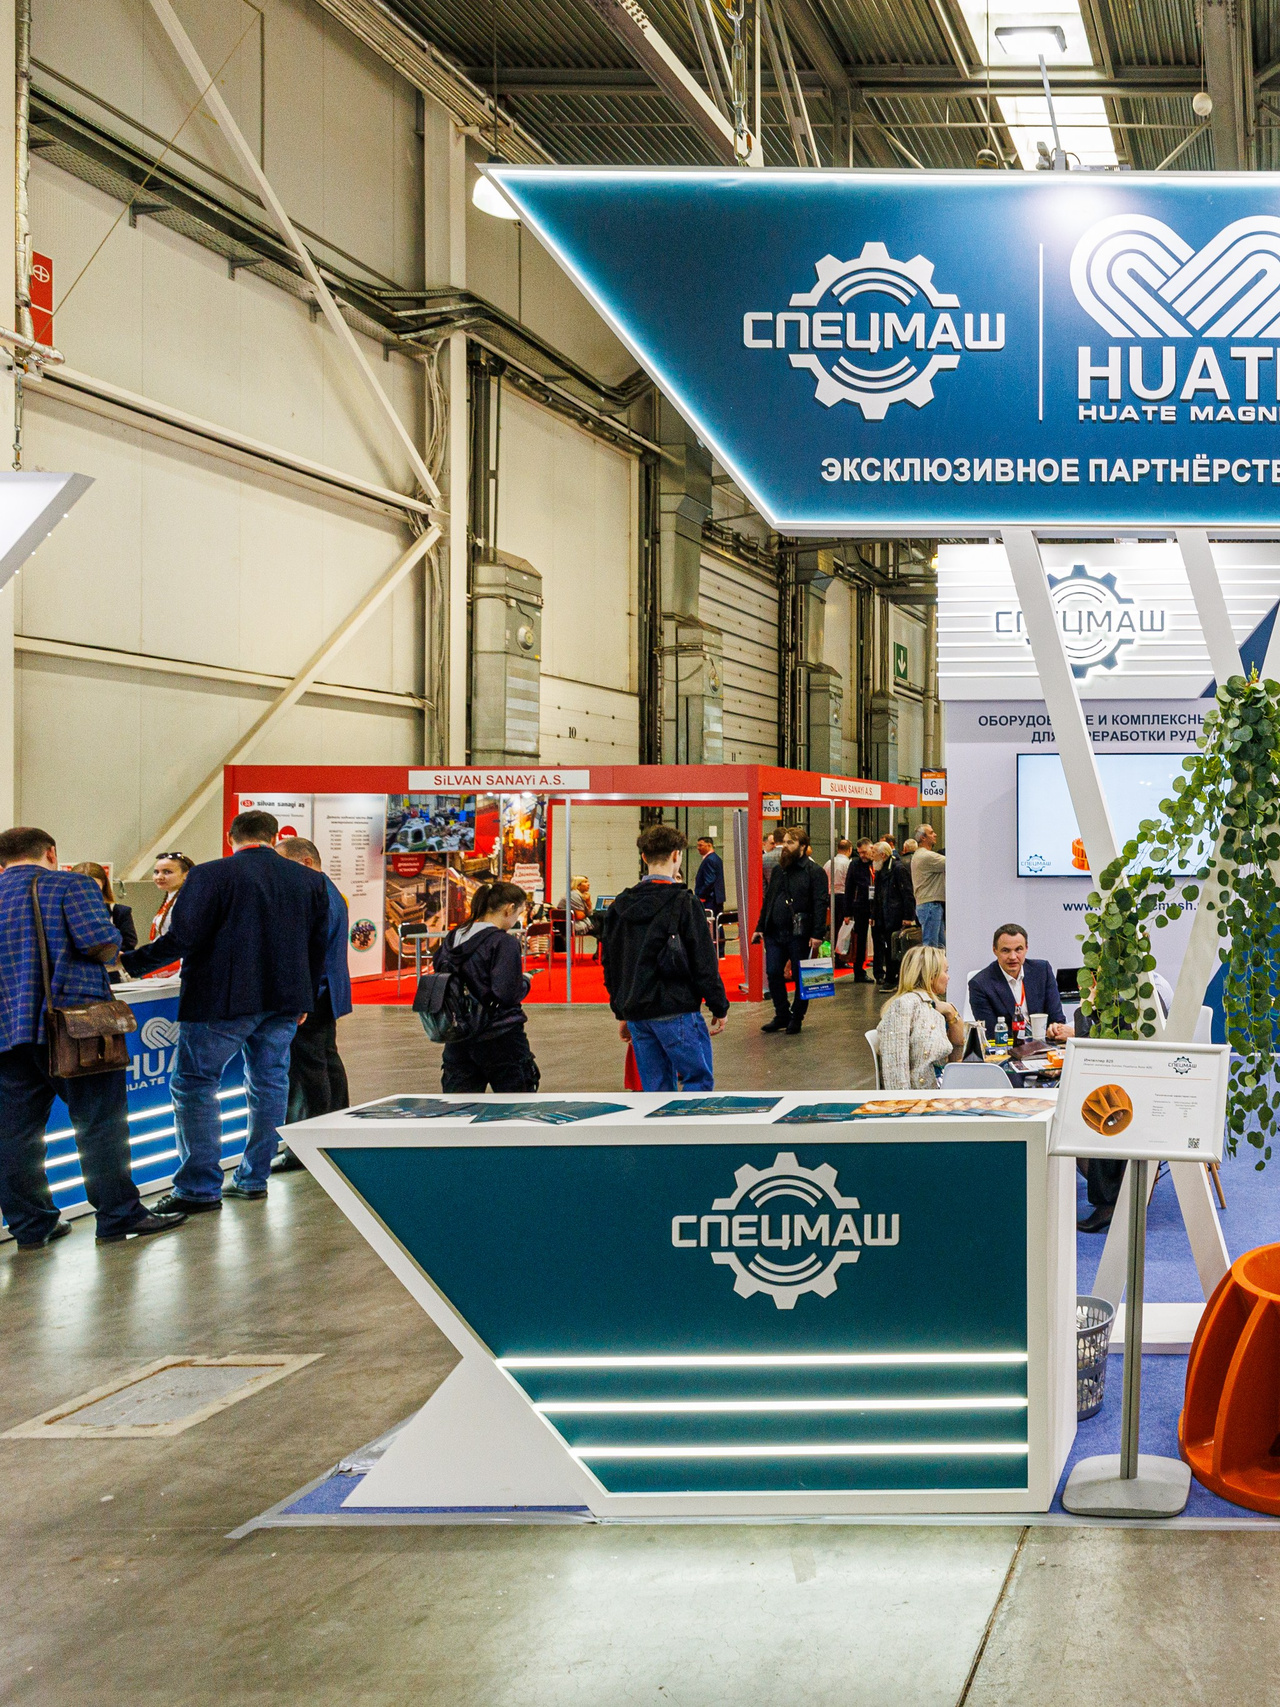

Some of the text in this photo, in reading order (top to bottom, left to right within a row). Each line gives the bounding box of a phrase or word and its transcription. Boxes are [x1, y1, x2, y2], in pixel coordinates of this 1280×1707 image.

[743, 312, 1006, 352] СПЕЦМАШ
[1079, 405, 1176, 422] HUATE
[821, 457, 1079, 483] ЭКСКЛЮЗИВНОЕ
[995, 610, 1165, 635] СЦМАШ
[1099, 715, 1107, 725] И
[1112, 714, 1205, 726] КОМПЛЕКСНЫ
[568, 726, 576, 739] 10
[539, 775, 565, 786] A.S.
[924, 788, 944, 796] 6049
[671, 1213, 900, 1250] СПЕЦМАШ
